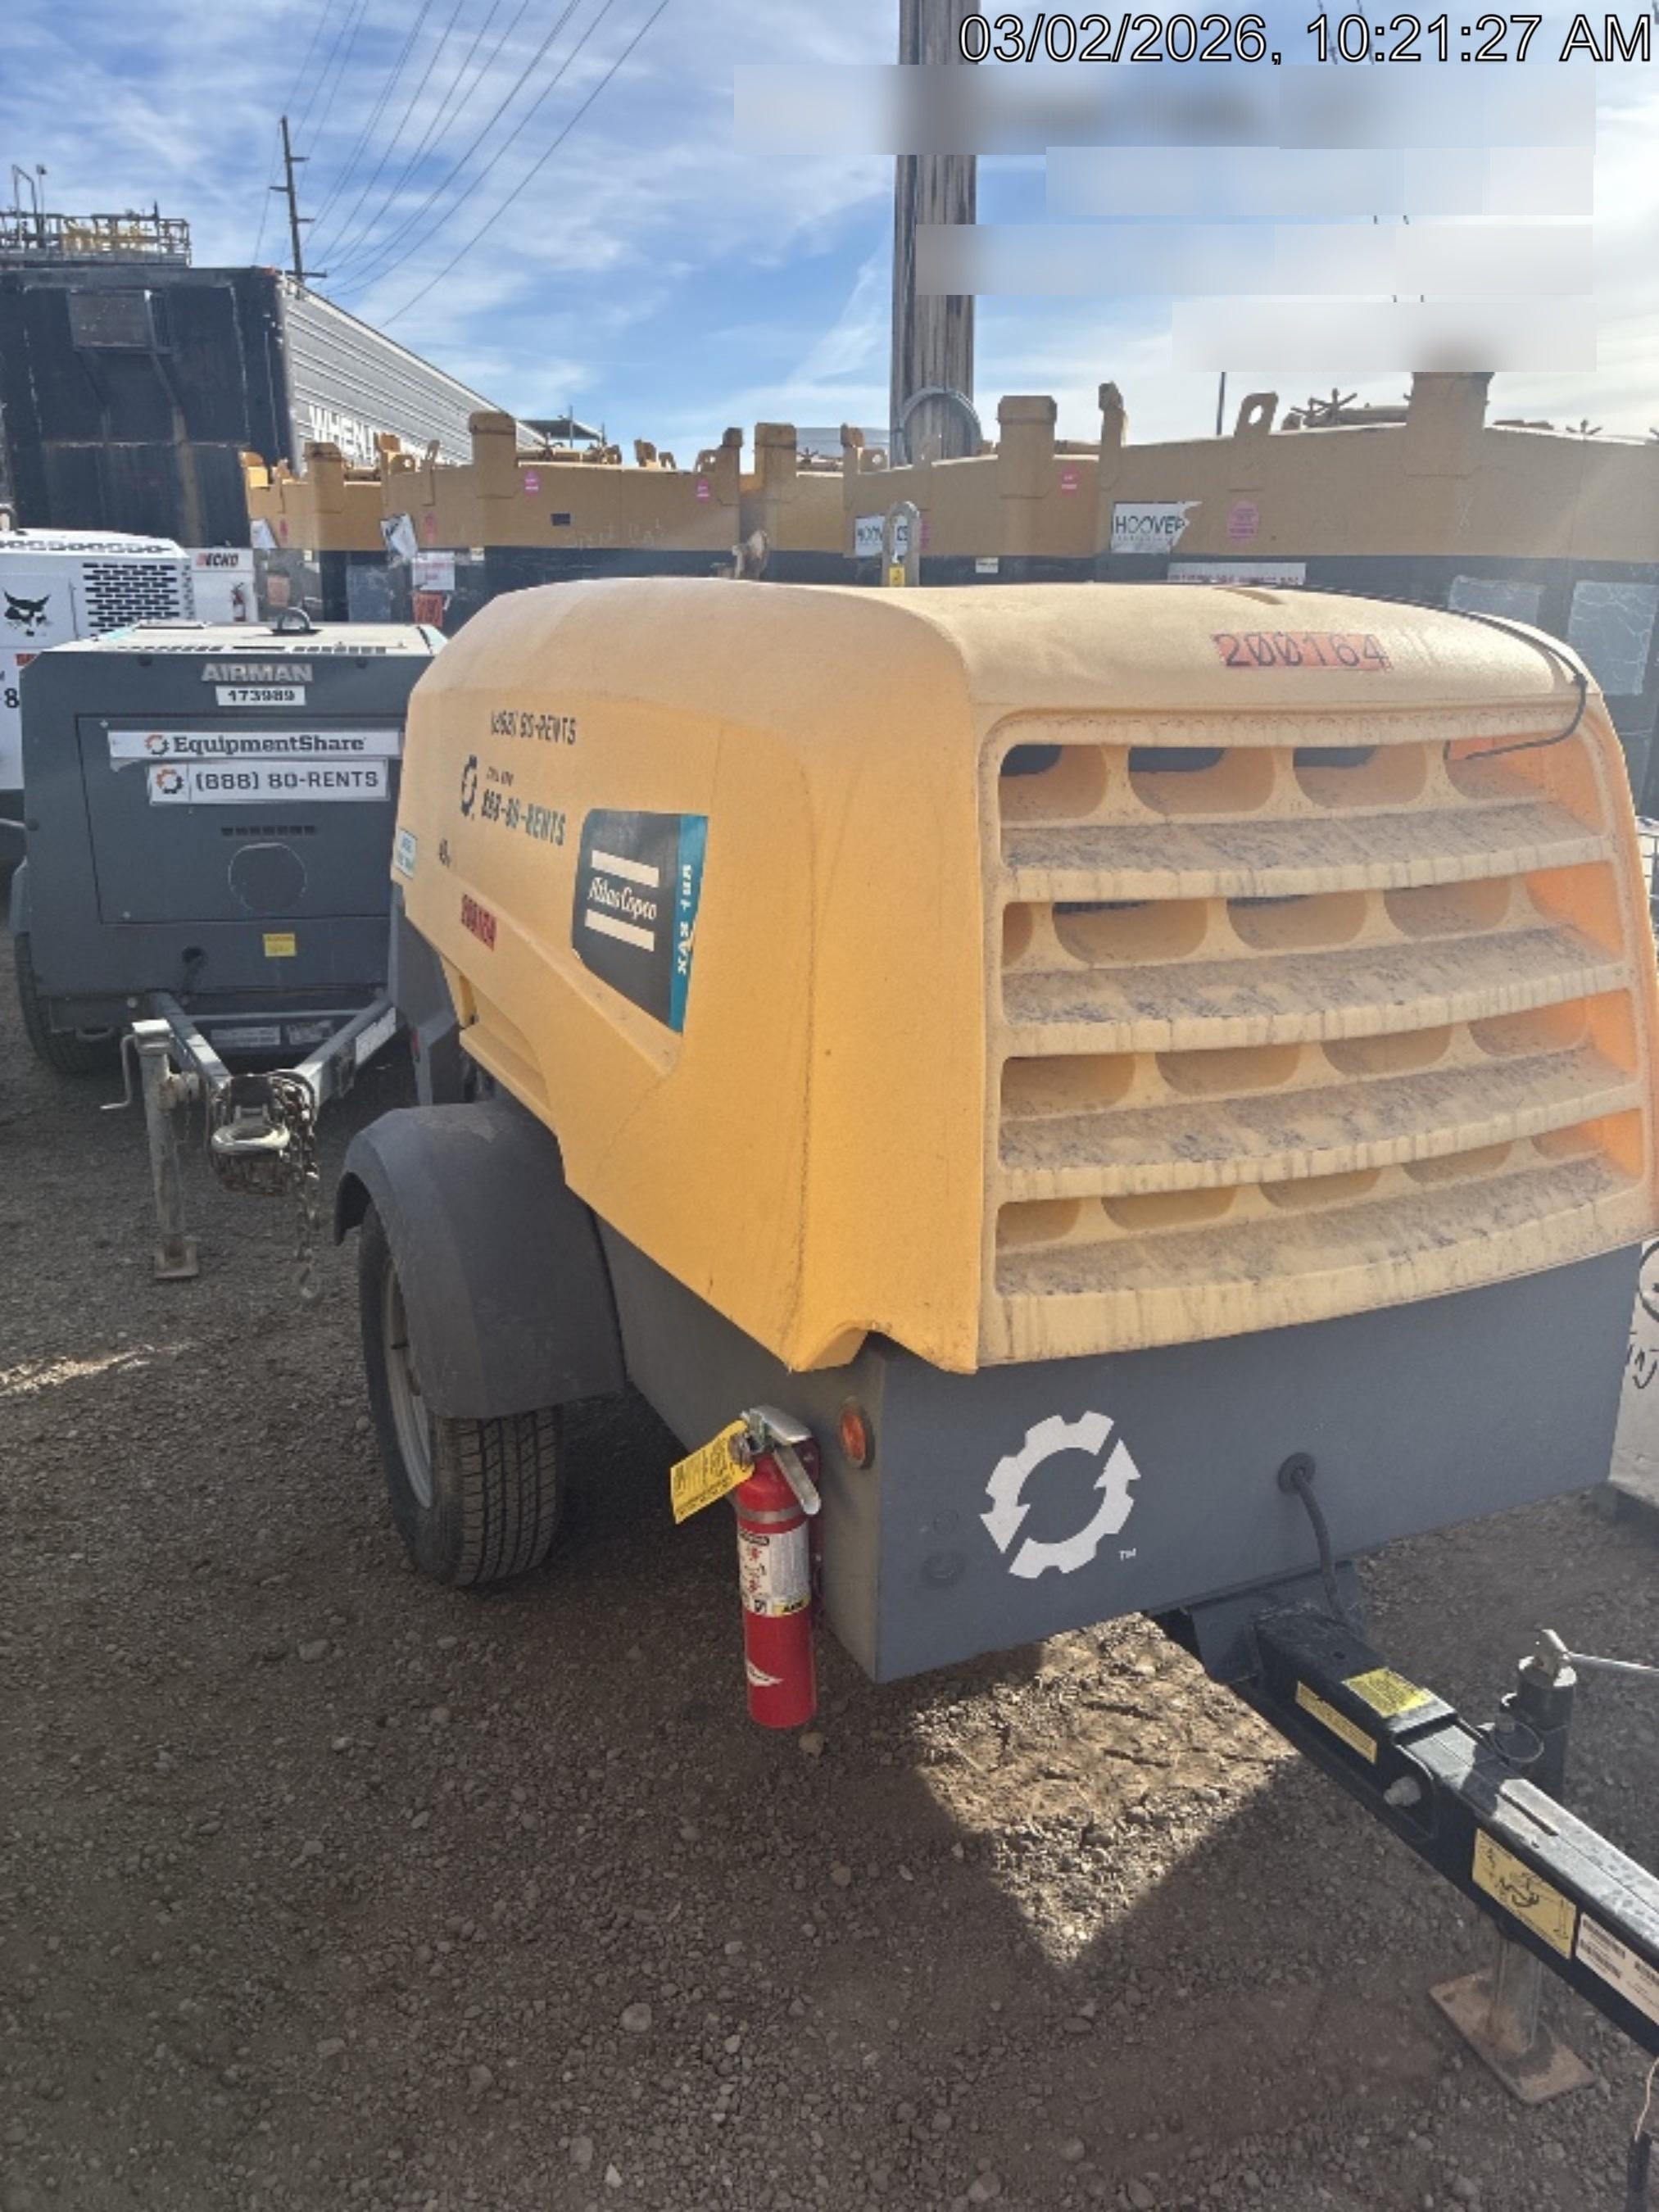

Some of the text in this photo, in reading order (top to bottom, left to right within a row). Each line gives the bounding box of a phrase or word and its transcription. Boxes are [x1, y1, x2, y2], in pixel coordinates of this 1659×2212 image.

[1213, 633, 1391, 669] 200164
[202, 663, 313, 682] AIRMAN
[174, 736, 365, 755] EquipmentShare
[268, 771, 378, 789] 80-RENTS
[1120, 1548, 1137, 1561] TM
